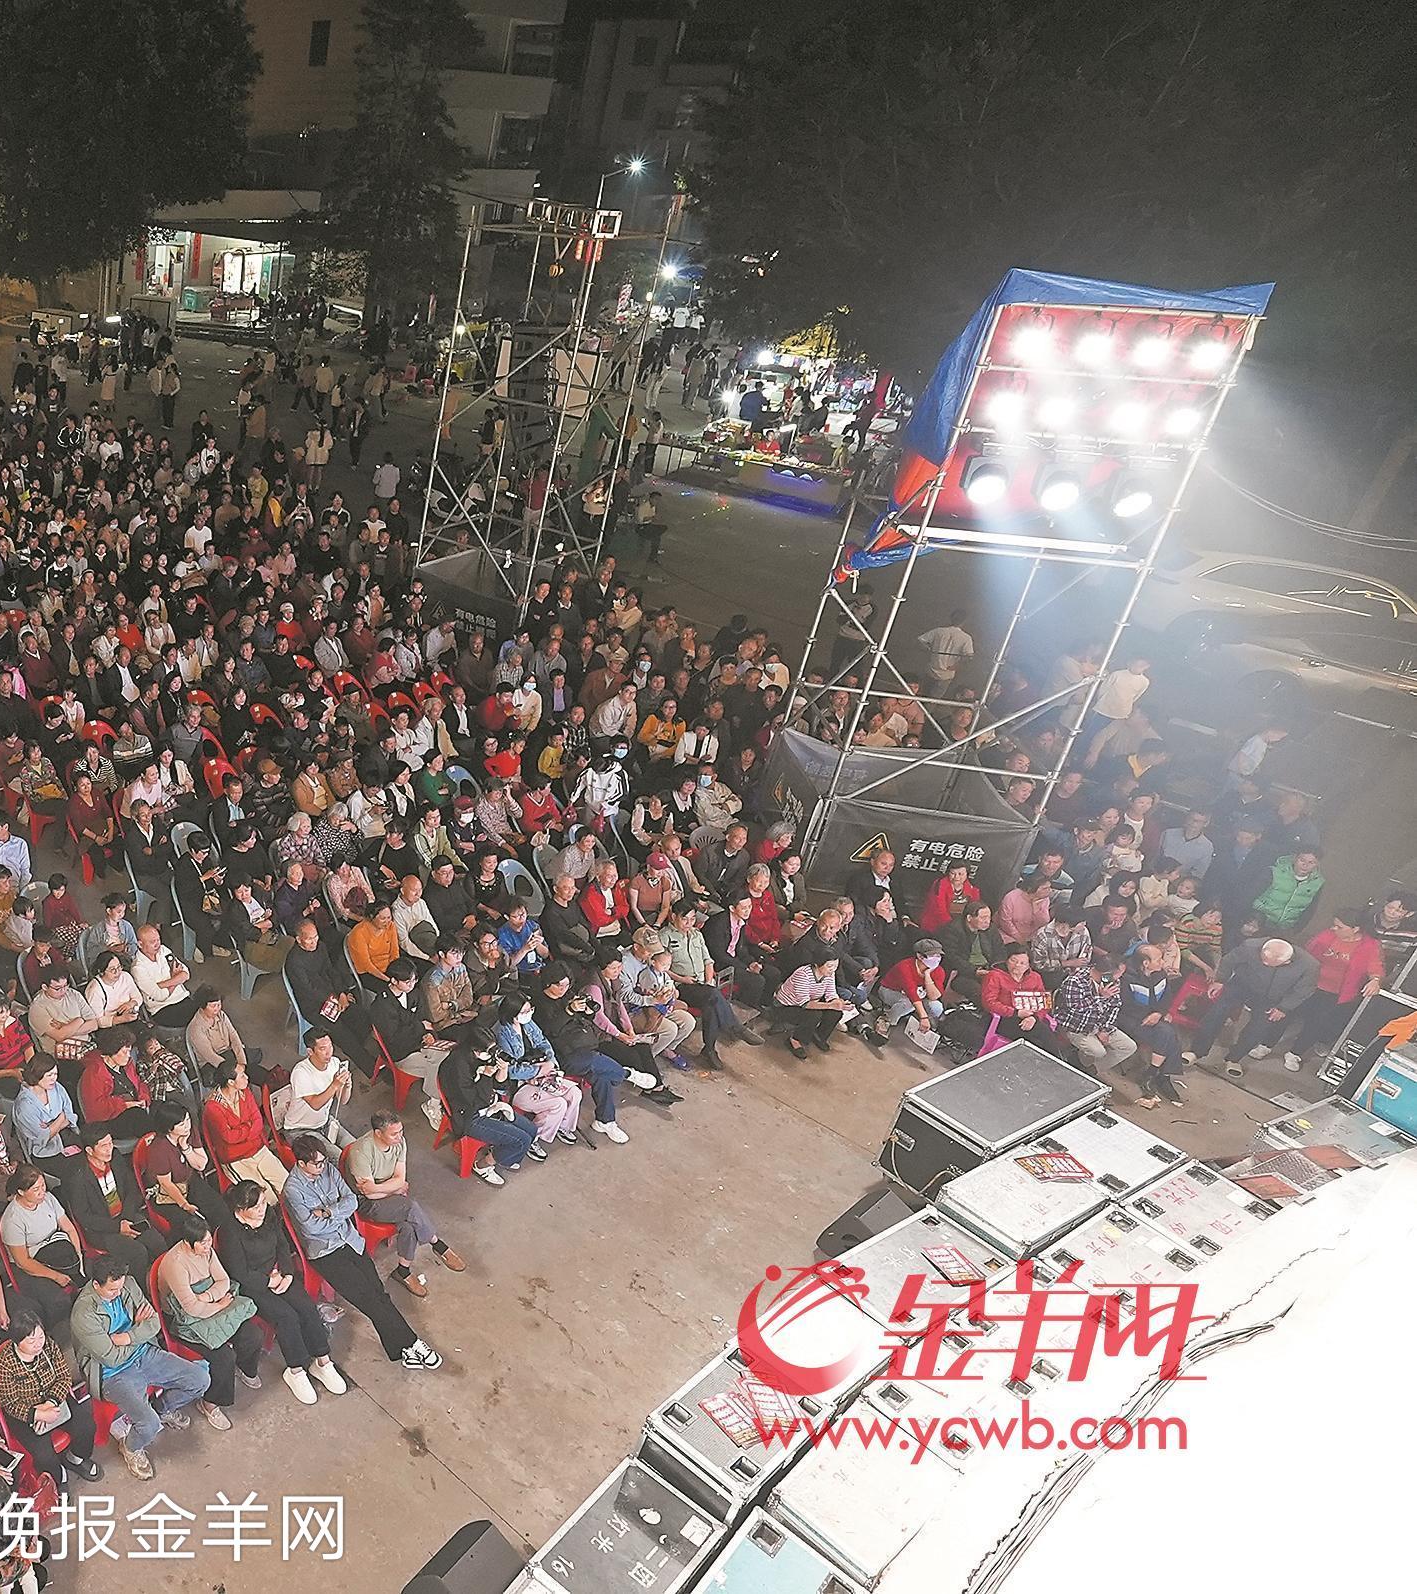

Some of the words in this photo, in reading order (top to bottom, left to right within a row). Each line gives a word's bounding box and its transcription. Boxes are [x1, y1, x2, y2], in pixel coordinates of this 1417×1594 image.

[909, 839, 985, 862] 有电危险
[590, 1510, 631, 1553] 灯光
[550, 1555, 575, 1578] 16
